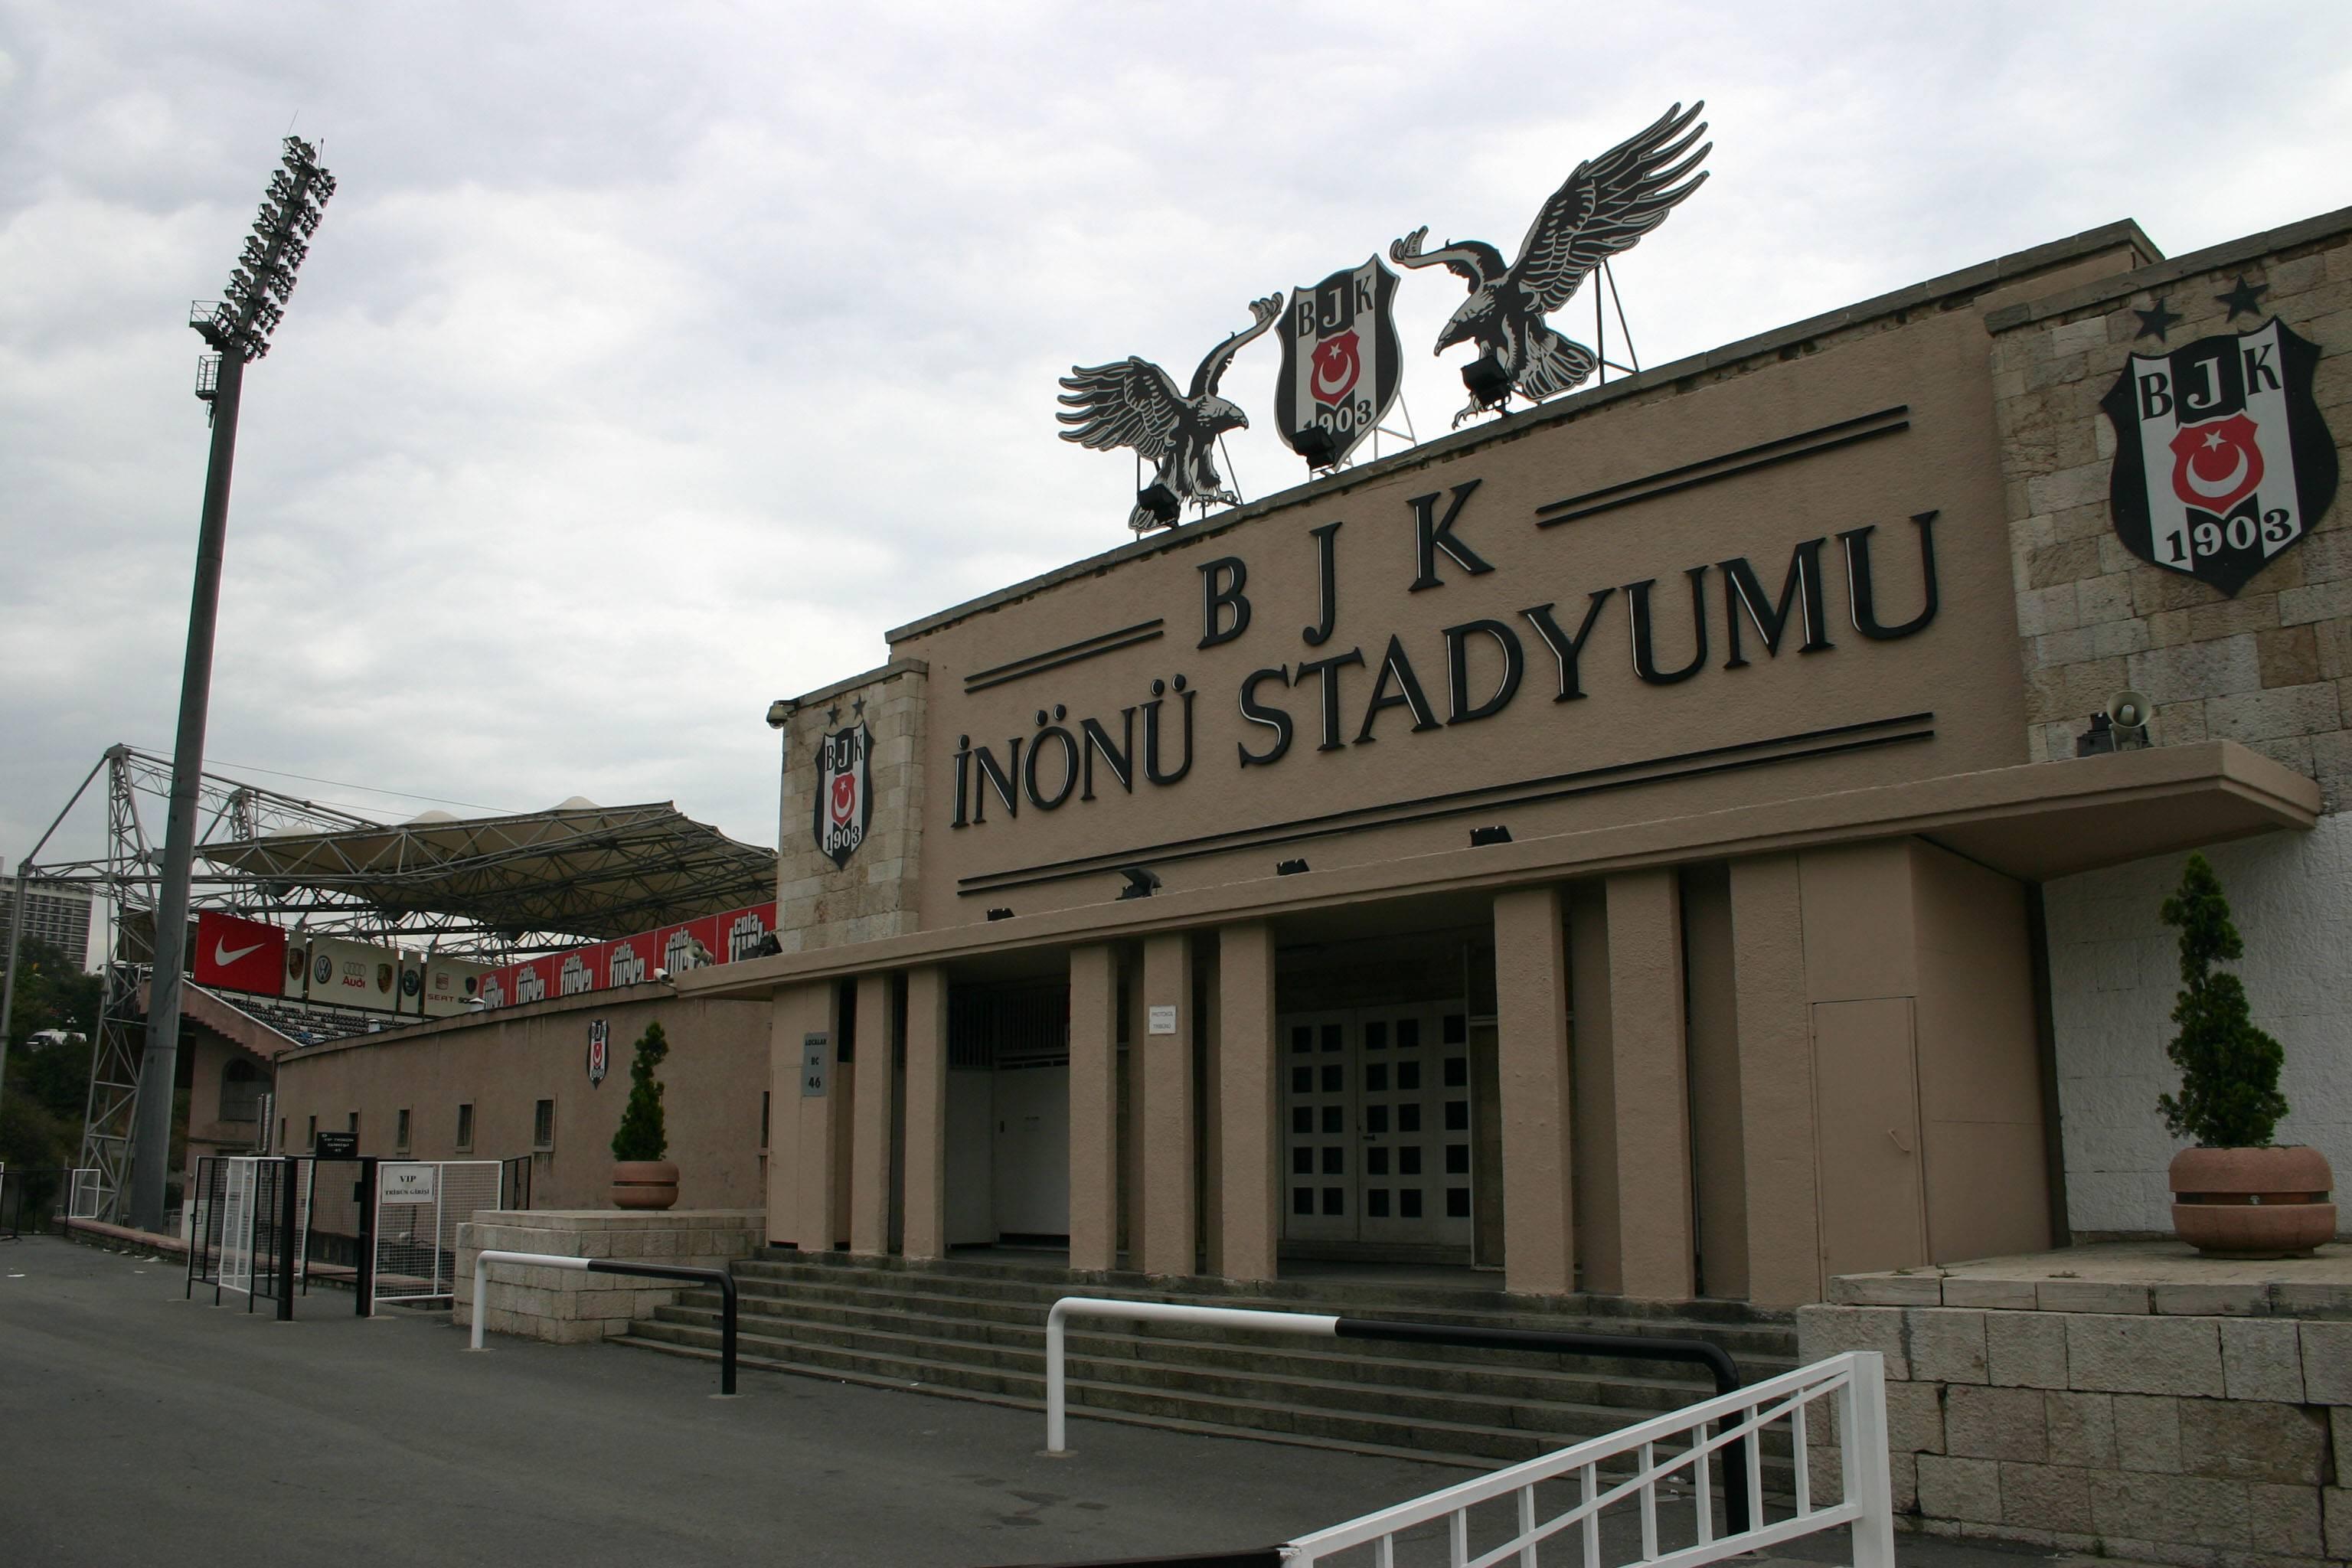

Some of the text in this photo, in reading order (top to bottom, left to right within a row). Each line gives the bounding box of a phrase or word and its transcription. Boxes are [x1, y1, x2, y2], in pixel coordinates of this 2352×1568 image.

[2165, 508, 2292, 563] 1903
[950, 509, 1940, 829] İNÖNÜ STADYUMU
[826, 825, 861, 852] 1903
[734, 911, 759, 936] cola
[669, 926, 689, 949] cola
[564, 952, 581, 972] cola
[614, 941, 632, 961] cola
[808, 1076, 821, 1088] 46
